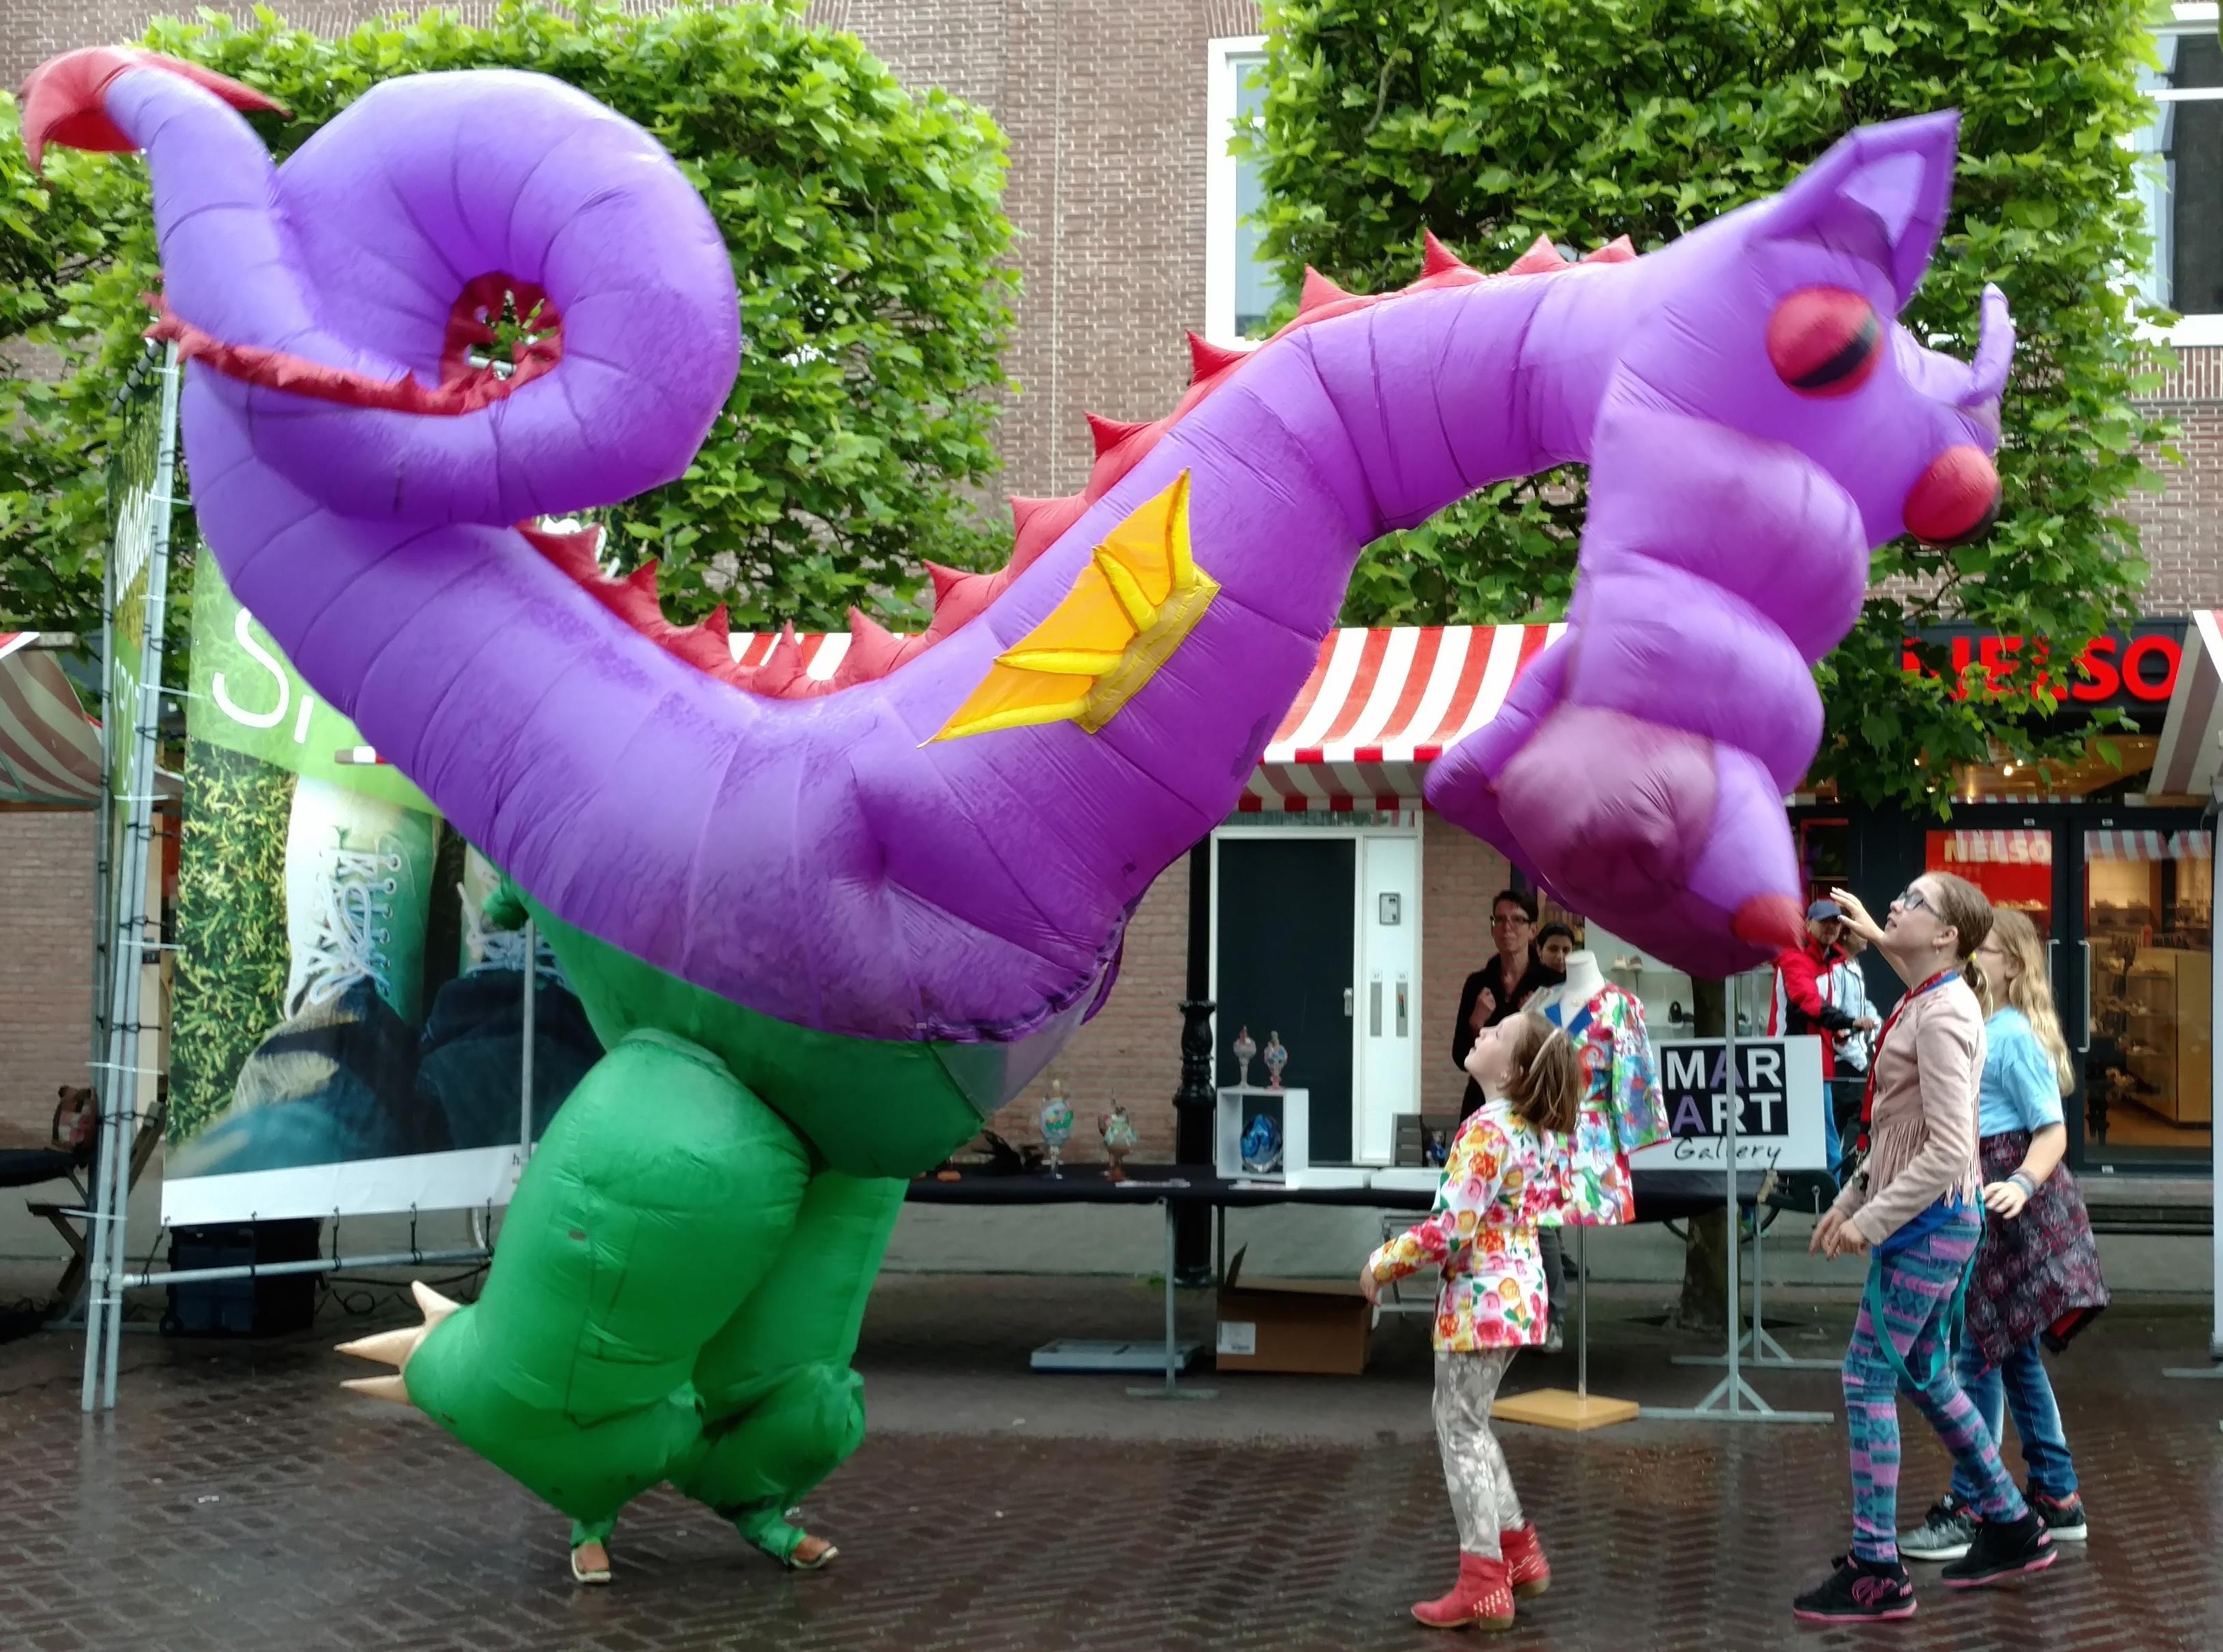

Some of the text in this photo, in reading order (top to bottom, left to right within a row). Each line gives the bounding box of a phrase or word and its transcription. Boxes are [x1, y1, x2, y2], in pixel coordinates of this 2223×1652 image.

[1666, 1048, 1783, 1090] MAR
[1672, 1092, 1783, 1134] ART
[1675, 1135, 1782, 1170] Galery
